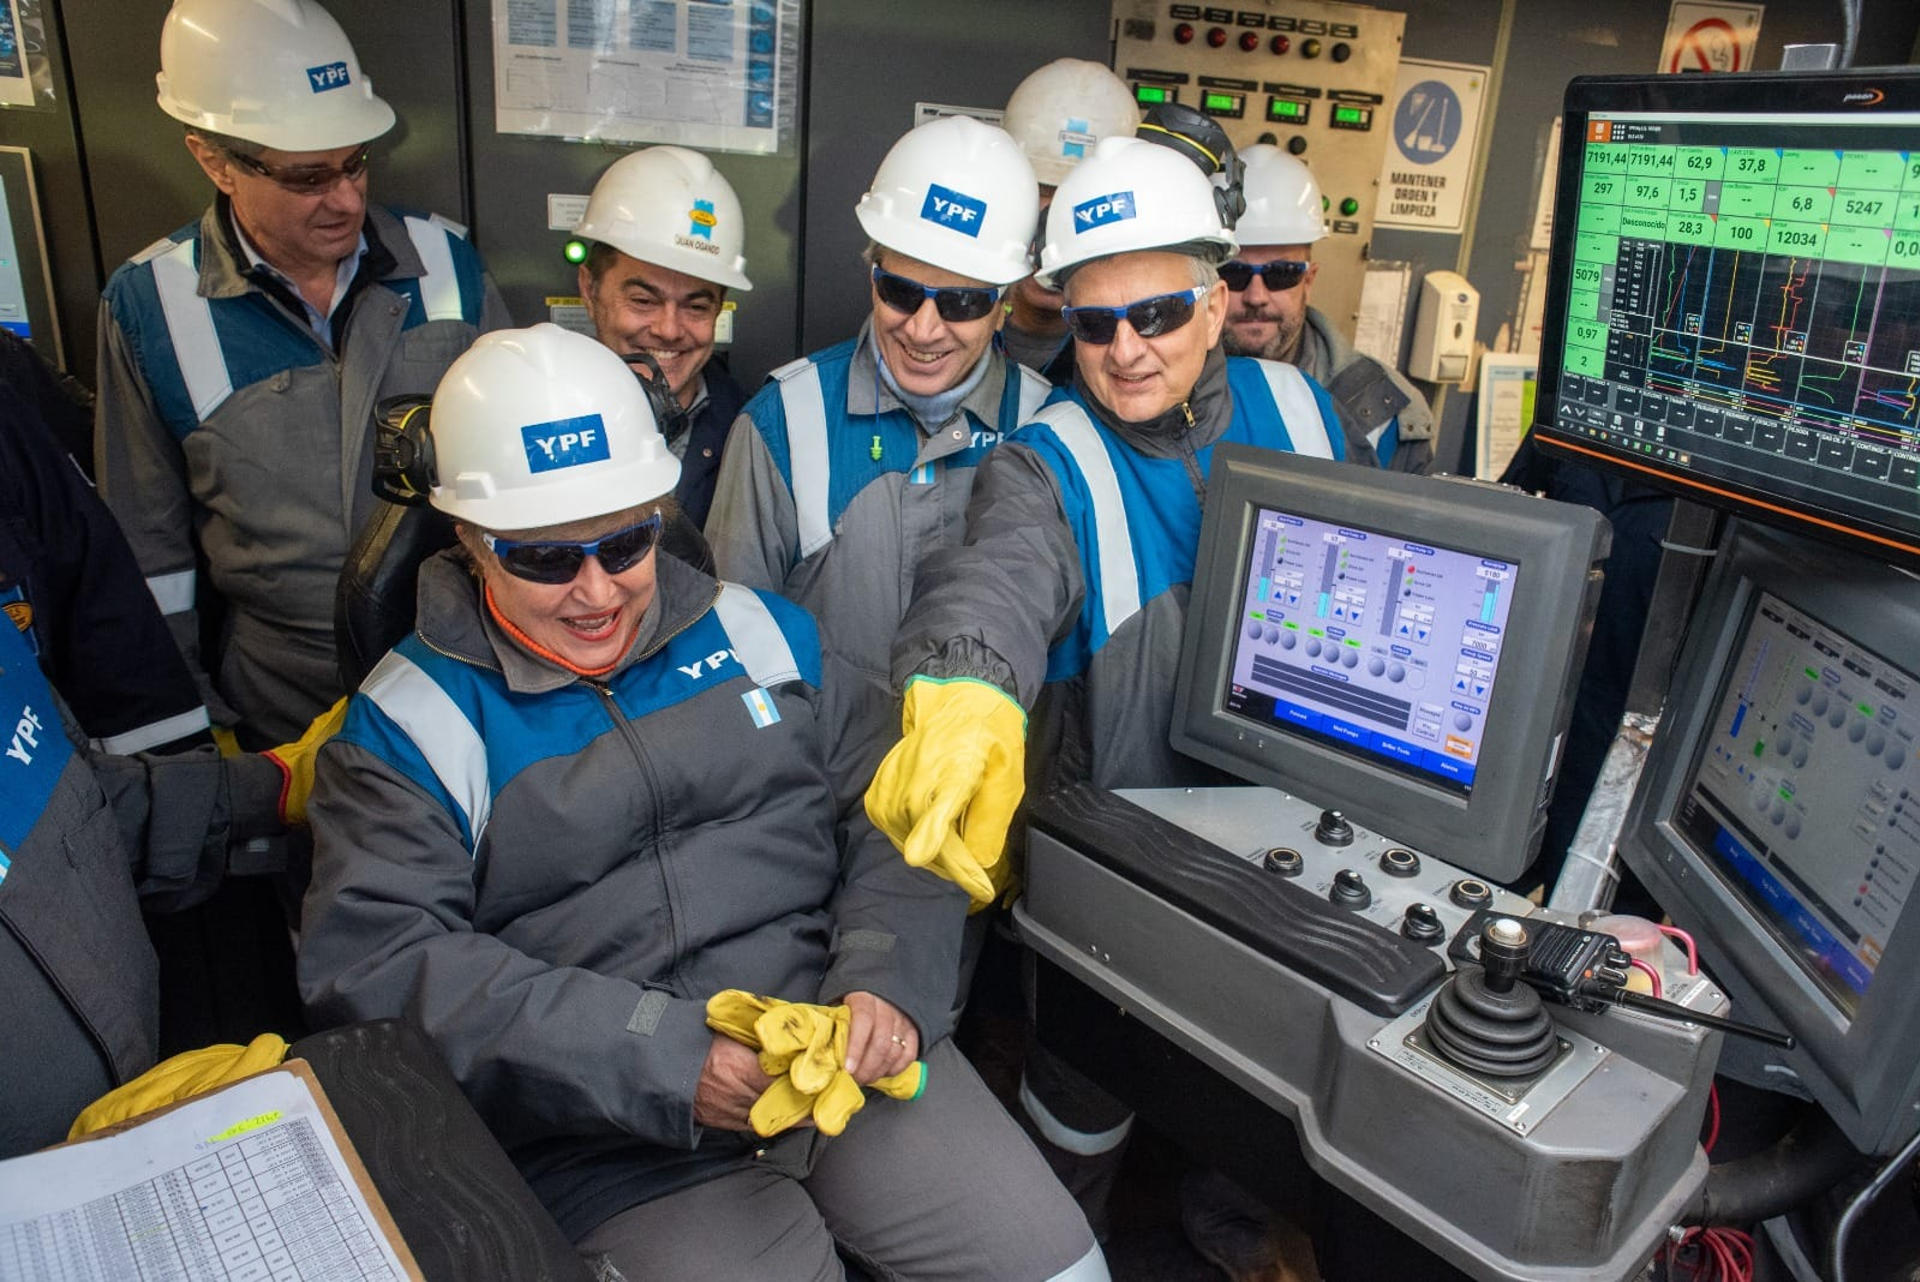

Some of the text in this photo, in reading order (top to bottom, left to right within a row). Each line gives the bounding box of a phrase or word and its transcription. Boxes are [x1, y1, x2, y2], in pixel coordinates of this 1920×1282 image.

[311, 67, 346, 86] YPF
[1587, 151, 1627, 166] 7191,44
[1630, 153, 1673, 168] 7191,44
[1687, 156, 1712, 170] 62,9
[1738, 158, 1766, 173] 37,8
[1390, 172, 1447, 188] MANTENER
[1394, 187, 1438, 202] ORDEN Y
[1593, 182, 1613, 194] 297
[1636, 185, 1659, 200] 97,6
[1679, 188, 1697, 202] 1,5
[932, 196, 977, 222] YPF
[1076, 199, 1126, 223] YPF
[1390, 203, 1437, 217] LIMPIEZA
[1792, 197, 1813, 212] 6,8
[1846, 200, 1883, 215] 5247
[1678, 221, 1703, 235] 28,3
[1730, 226, 1753, 240] 100
[1777, 230, 1817, 247] 12034
[1575, 268, 1600, 282] 5079
[1577, 327, 1598, 339] 0,97
[1580, 356, 1587, 367] 2
[535, 429, 596, 455] YPF
[6, 705, 44, 766] YPF
